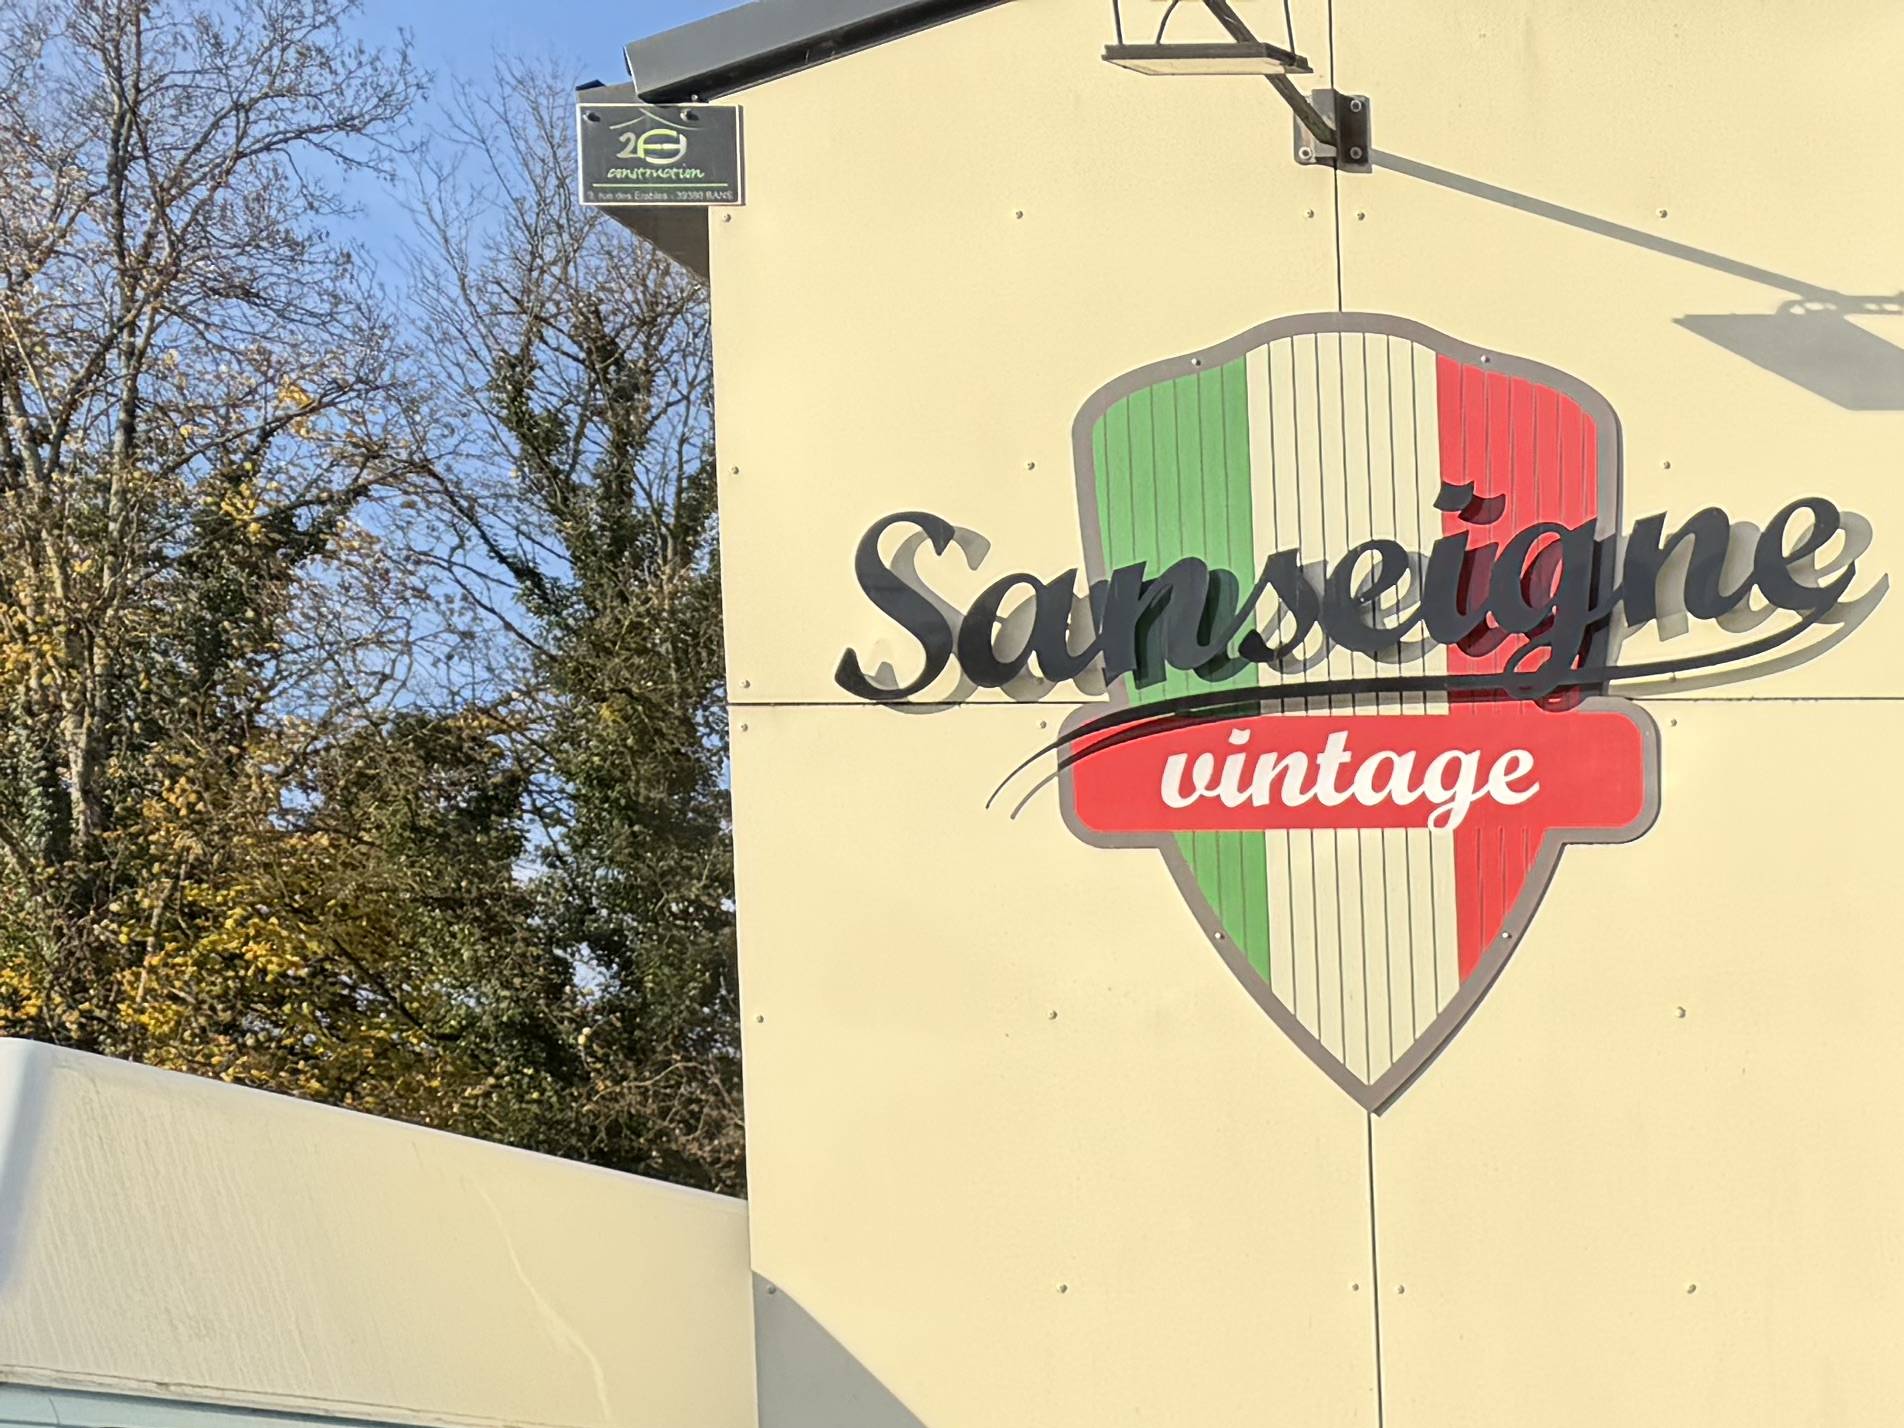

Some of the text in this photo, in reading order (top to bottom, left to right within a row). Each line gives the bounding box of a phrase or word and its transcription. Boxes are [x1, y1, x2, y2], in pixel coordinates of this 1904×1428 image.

[608, 165, 704, 181] construction
[834, 481, 1858, 700] Sanseigne
[1160, 729, 1541, 831] vintage
